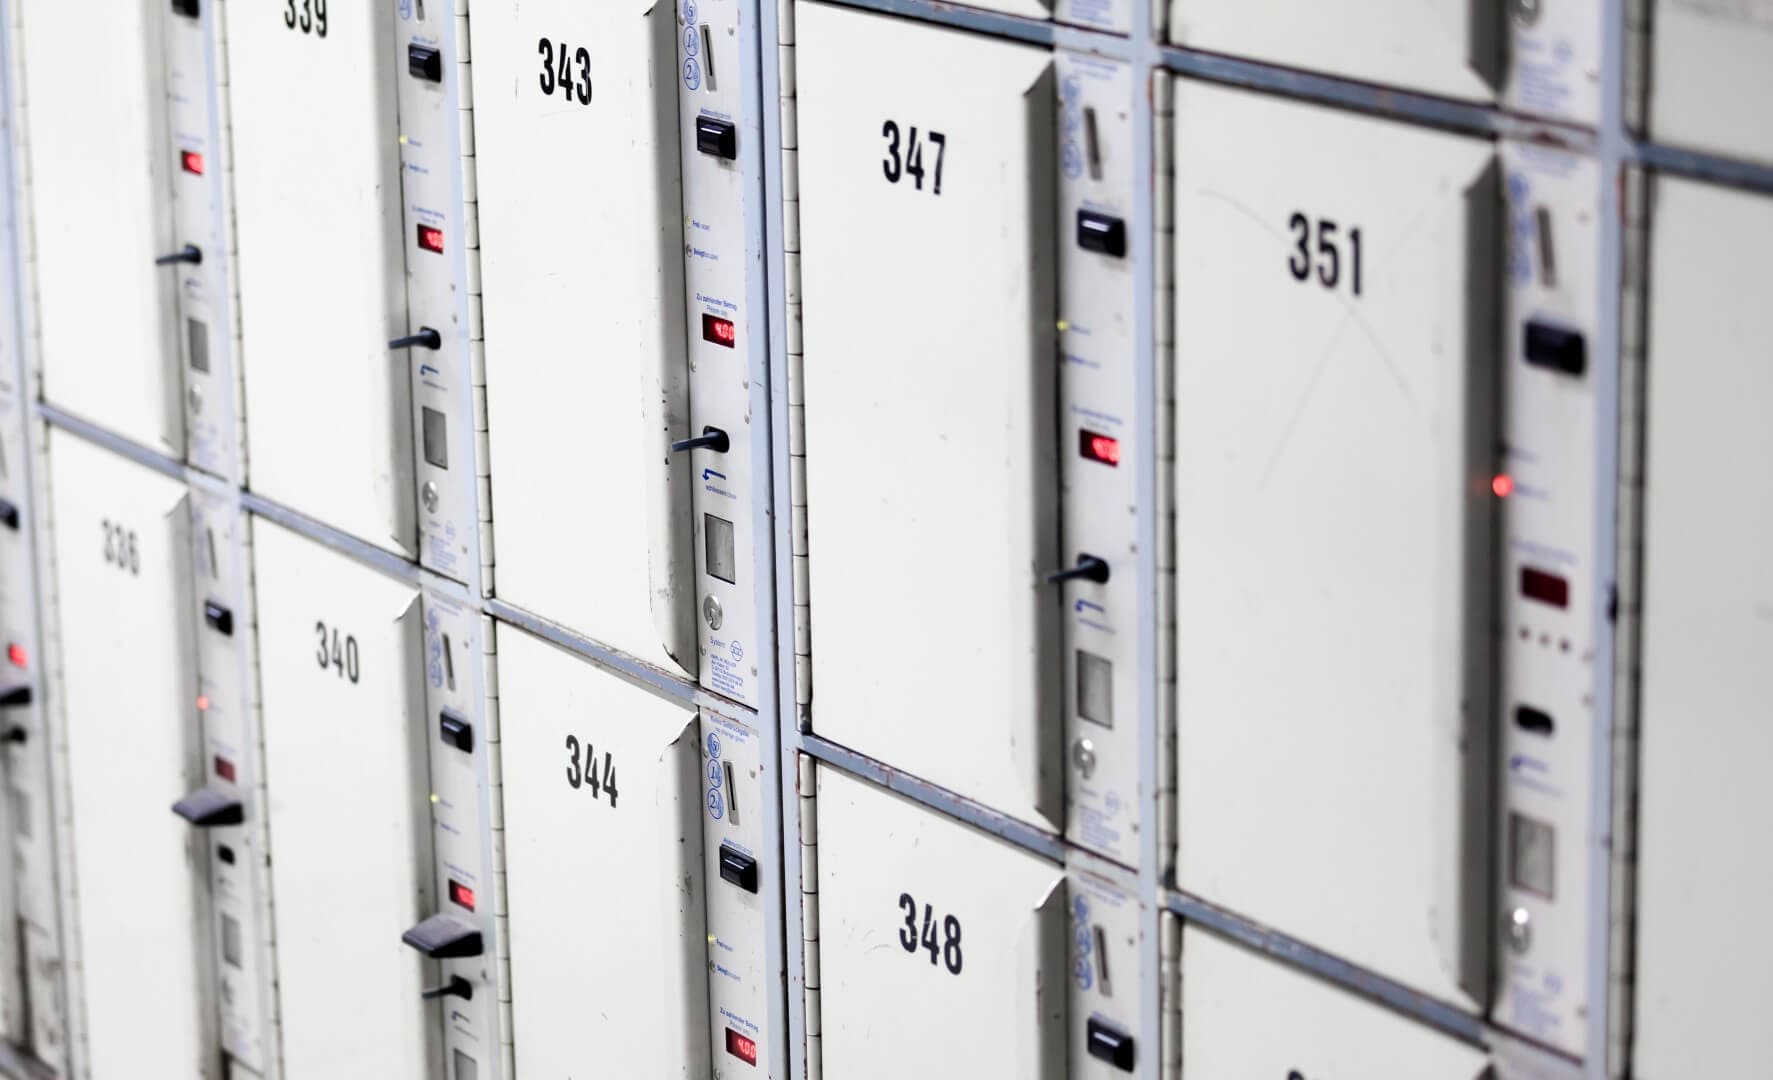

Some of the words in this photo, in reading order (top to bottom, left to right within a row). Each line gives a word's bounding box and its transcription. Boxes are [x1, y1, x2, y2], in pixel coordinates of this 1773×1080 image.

[538, 37, 593, 106] 343
[882, 119, 946, 196] 347
[1287, 212, 1363, 297] 351
[100, 518, 141, 577] 336
[314, 620, 361, 685] 340
[565, 734, 619, 809] 344
[897, 892, 964, 976] 348
